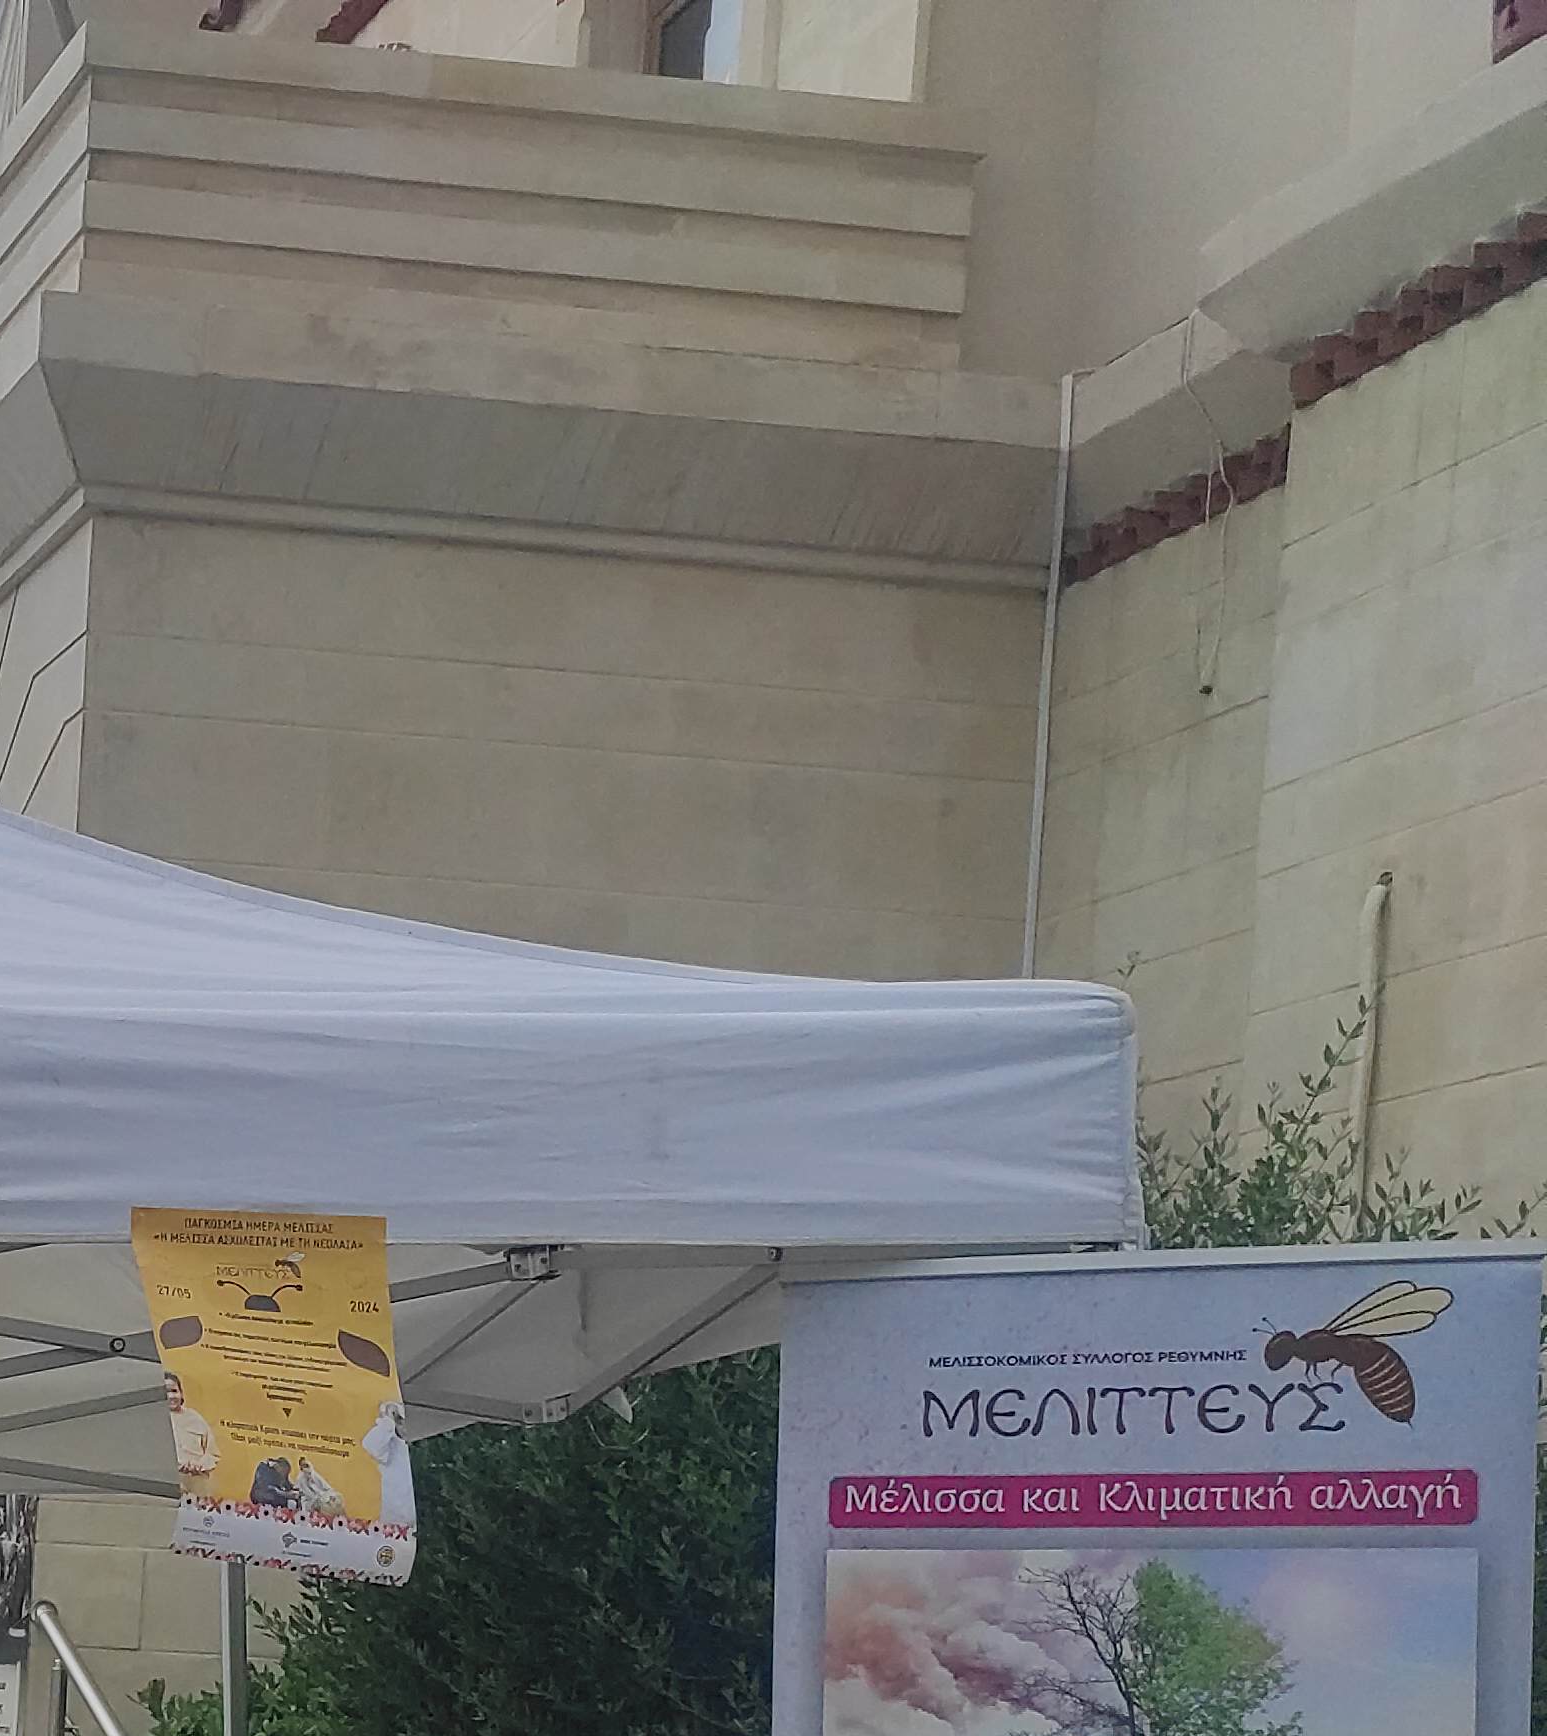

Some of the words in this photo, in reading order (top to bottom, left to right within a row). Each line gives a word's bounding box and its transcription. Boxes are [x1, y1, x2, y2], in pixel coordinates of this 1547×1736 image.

[157, 1284, 192, 1299] 27/05
[349, 1300, 380, 1314] 2024
[928, 1352, 1068, 1370] ΜΕΛΙΣΣΟΚΟΜΙΚΟΣ
[1072, 1351, 1153, 1366] ΣΥΛΛΟΓΟΣ
[1158, 1348, 1248, 1364] ΡΕΘΥΜΝΗΣ
[921, 1382, 1347, 1438] ΜΕΛΙΤΤΕΥΣ
[844, 1480, 1006, 1516] Μέλισσα
[1021, 1485, 1080, 1513] και
[1098, 1474, 1294, 1521] Κλιματική
[1310, 1474, 1463, 1521] αλλαγή
